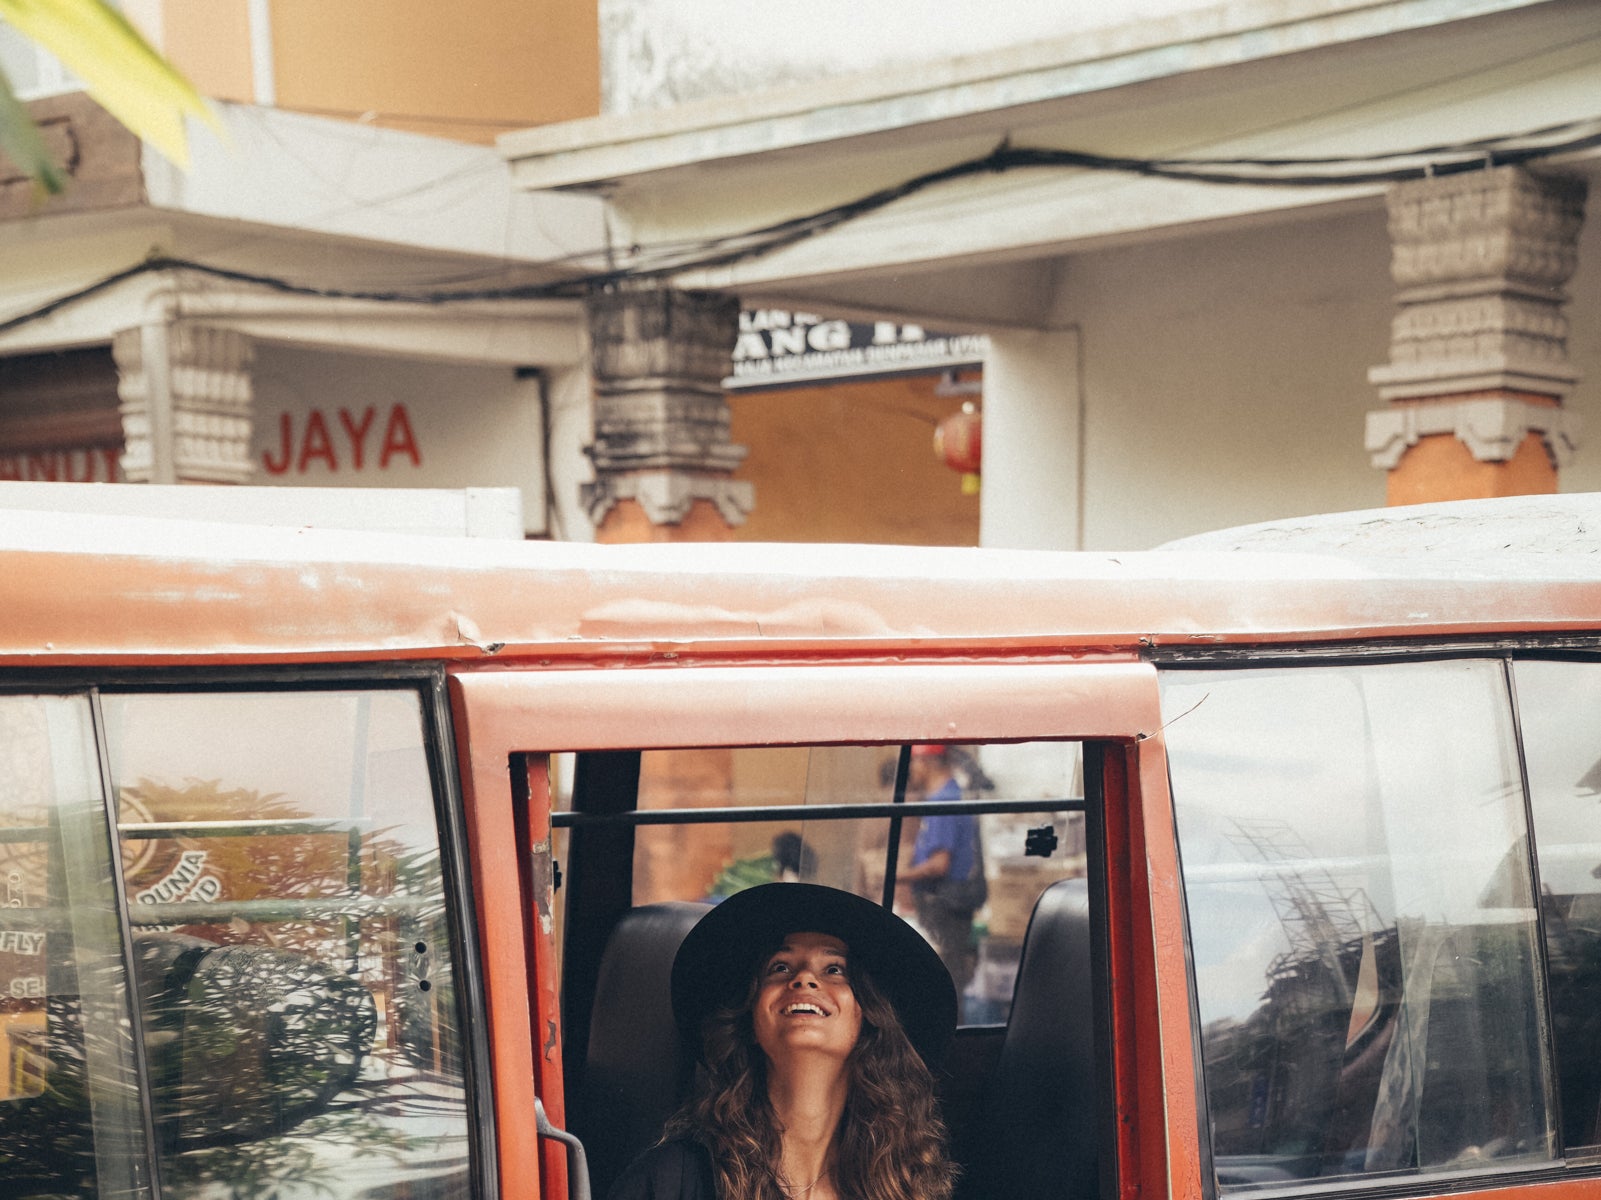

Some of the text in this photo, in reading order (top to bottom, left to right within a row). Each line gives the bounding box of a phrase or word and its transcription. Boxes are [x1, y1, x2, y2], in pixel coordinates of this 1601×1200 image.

[263, 402, 421, 475] JAYA
[137, 850, 207, 904] DUNIA
[0, 930, 46, 954] FLY
